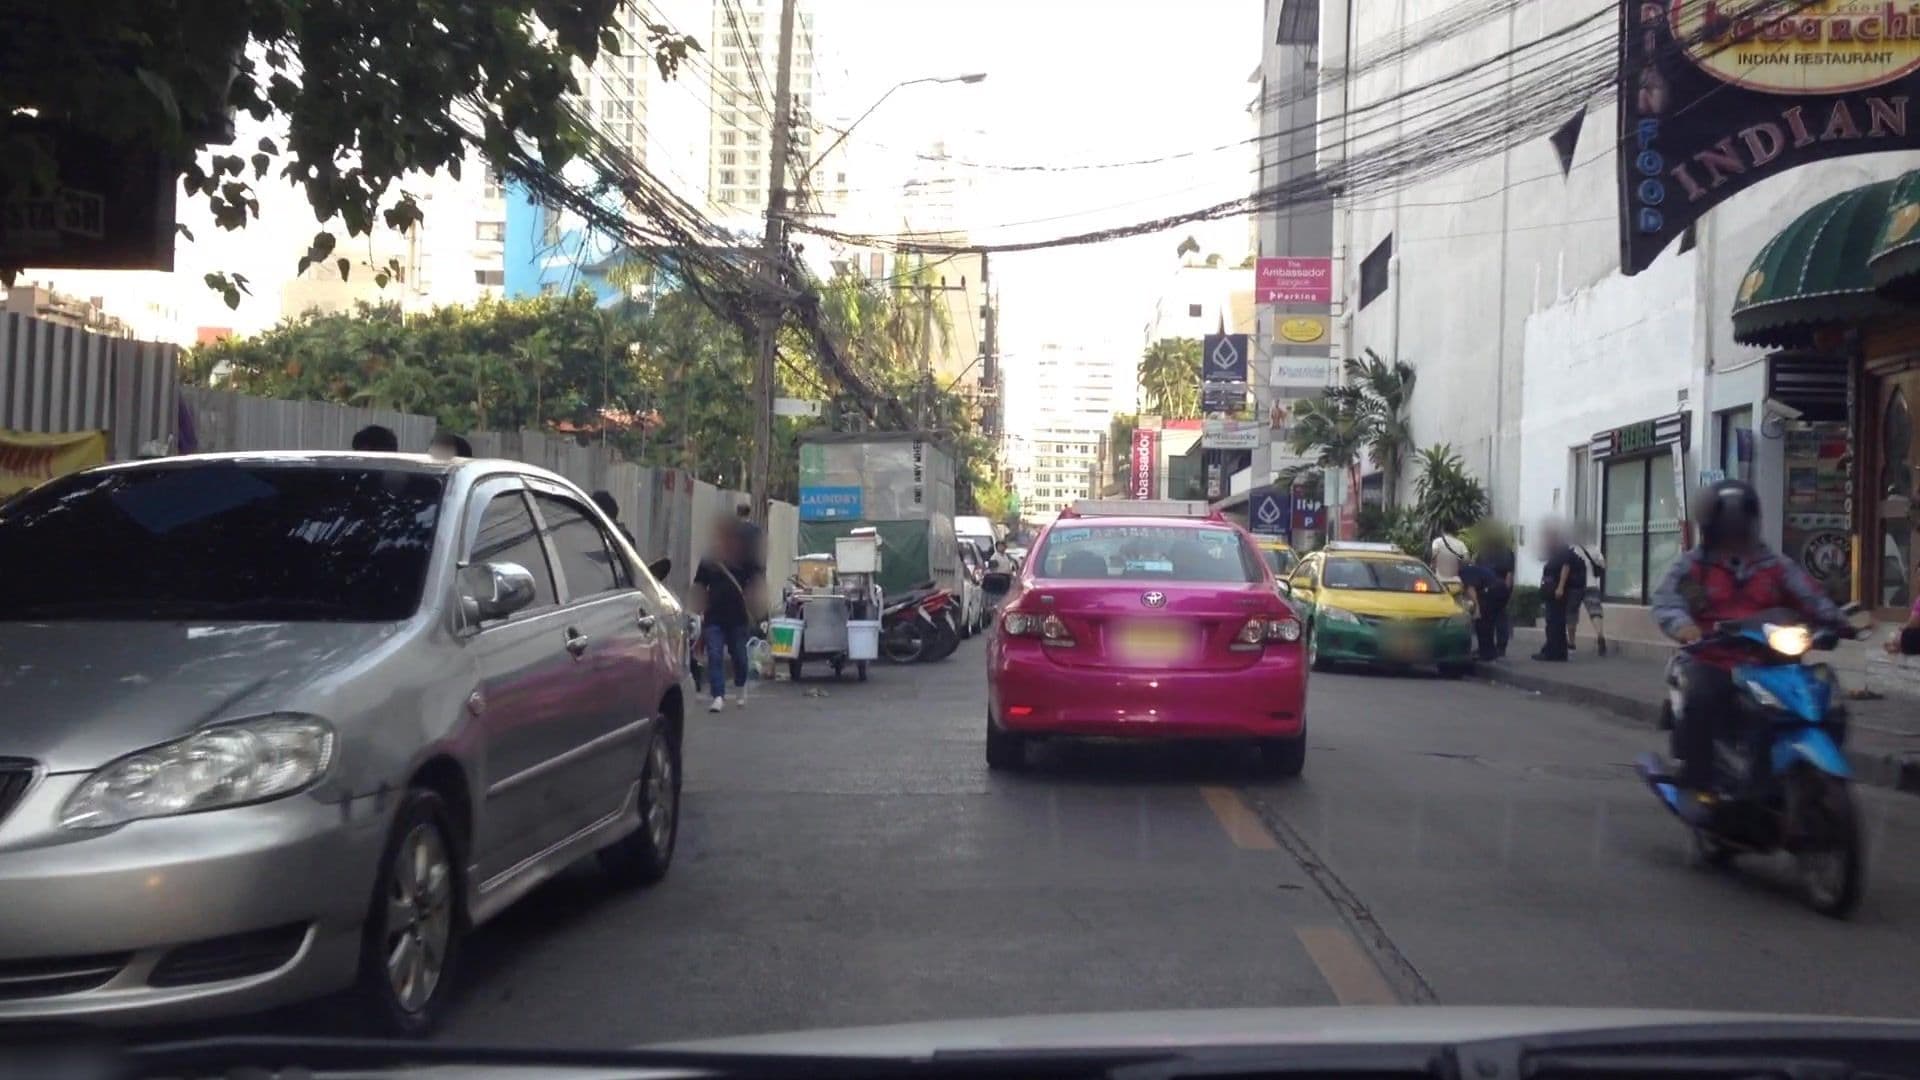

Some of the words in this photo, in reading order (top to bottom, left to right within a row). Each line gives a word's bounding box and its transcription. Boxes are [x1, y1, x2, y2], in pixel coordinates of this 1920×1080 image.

[1738, 53, 1783, 65] INDIAN
[1794, 53, 1893, 65] RESTAURANT
[1671, 96, 1909, 202] INDIAN
[1637, 118, 1664, 233] FOOD
[1262, 268, 1325, 277] Ambassador
[801, 495, 858, 505] LAUNDRY
[1304, 516, 1314, 528] P
